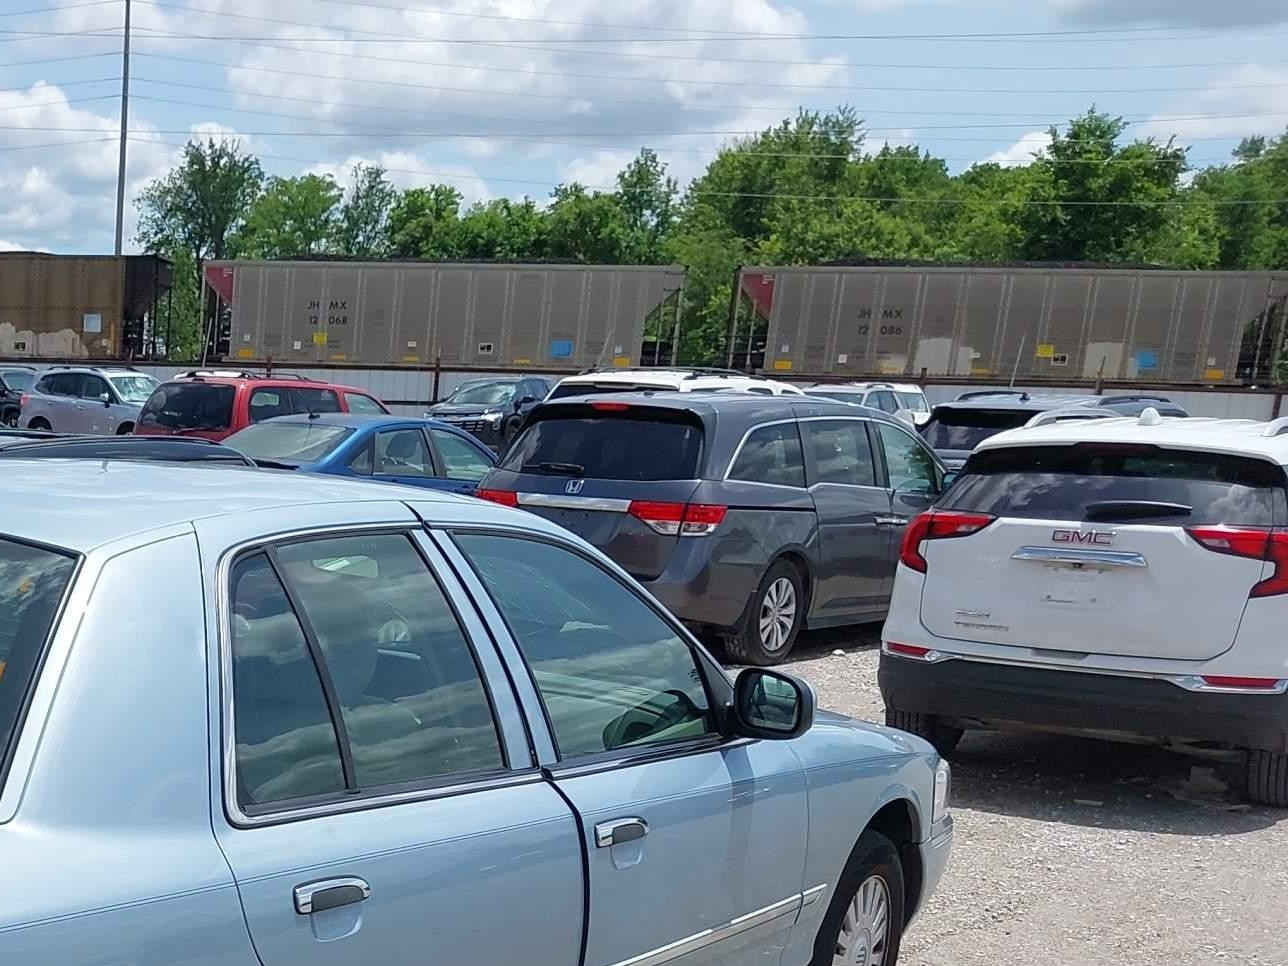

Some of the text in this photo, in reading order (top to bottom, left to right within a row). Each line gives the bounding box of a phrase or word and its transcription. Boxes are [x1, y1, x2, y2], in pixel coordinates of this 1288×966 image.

[307, 300, 347, 310] JH MX
[857, 309, 903, 319] JH MX
[309, 315, 348, 325] 12 068
[857, 325, 902, 335] 12 086
[1051, 529, 1116, 546] GMC
